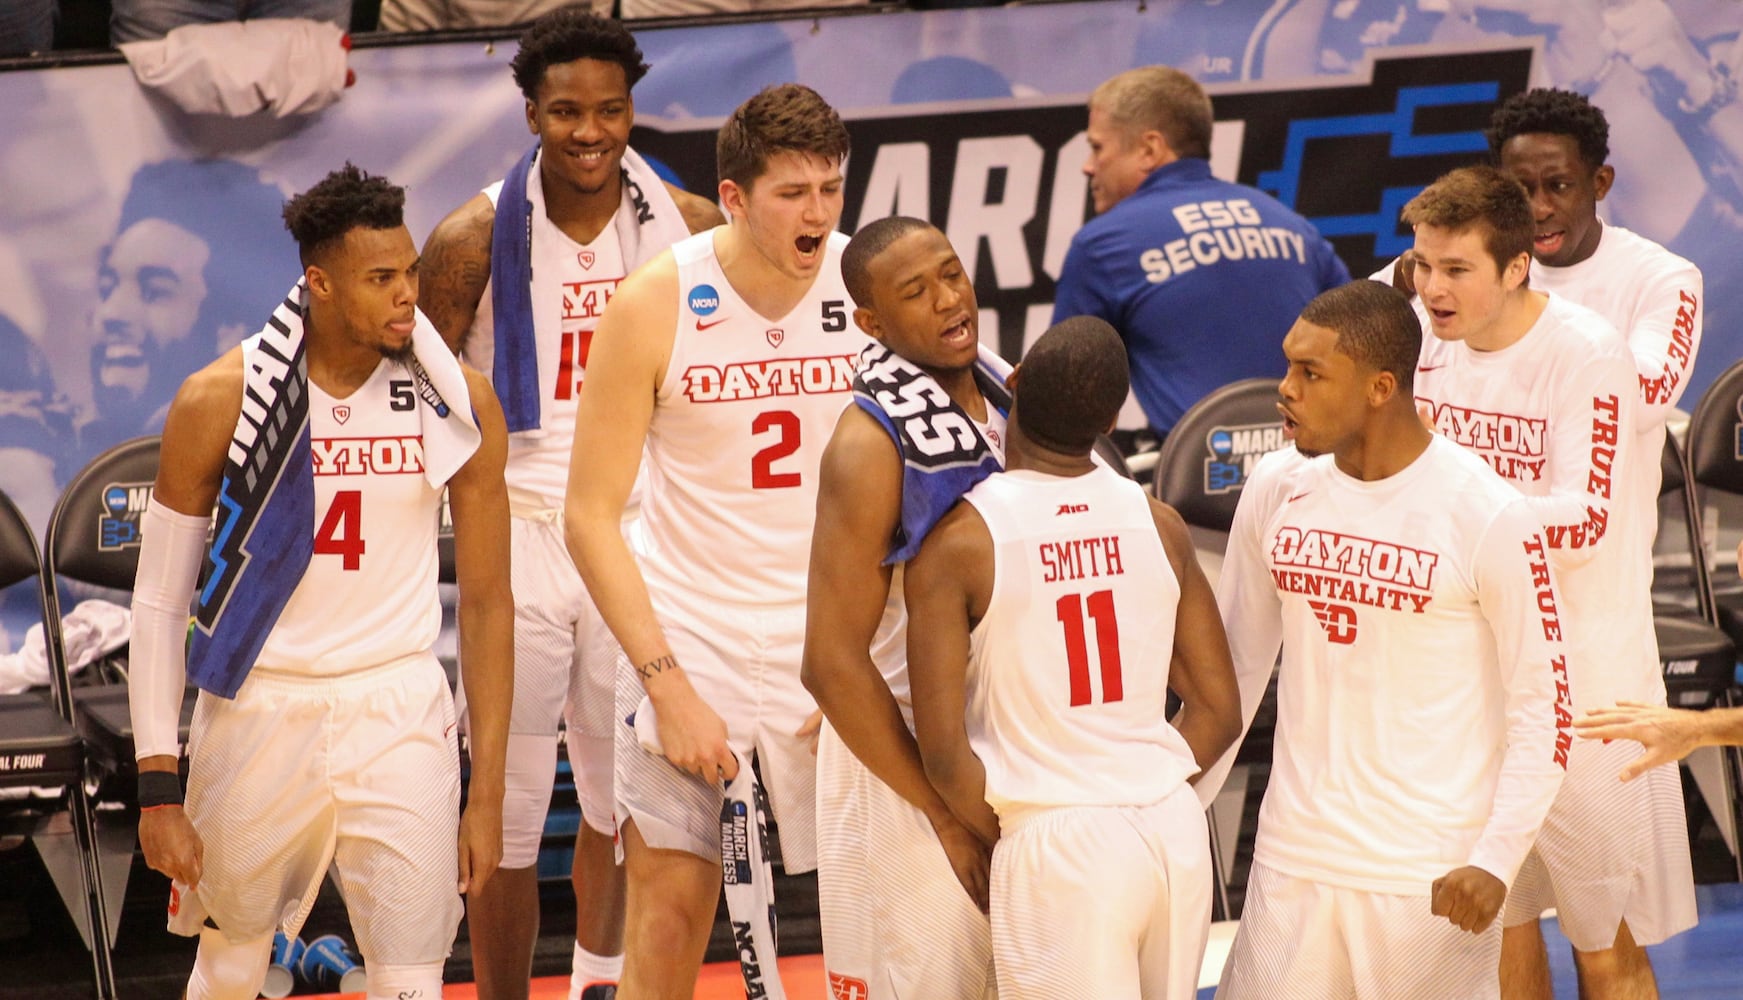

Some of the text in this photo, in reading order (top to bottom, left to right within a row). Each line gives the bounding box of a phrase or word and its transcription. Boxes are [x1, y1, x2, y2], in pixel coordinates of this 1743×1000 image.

[1172, 199, 1262, 235] ESG
[1139, 227, 1306, 285] SECURITY
[692, 298, 718, 309] NCAA
[821, 300, 847, 333] 5
[1668, 289, 1697, 371] TRUE
[389, 380, 416, 412] 5
[751, 410, 802, 490] 2
[1587, 394, 1619, 499] TRUE
[313, 489, 366, 572] 4
[1039, 536, 1125, 583] SMITH
[1271, 526, 1439, 590] DAYTON
[1270, 569, 1433, 614] MENTALITY
[1056, 589, 1124, 707] 11
[1522, 533, 1574, 771] TRUE TEAM
[1666, 660, 1699, 674] FOUR
[13, 753, 44, 770] FOUR
[721, 822, 738, 885] MADNESS
[733, 815, 747, 861] MARCH
